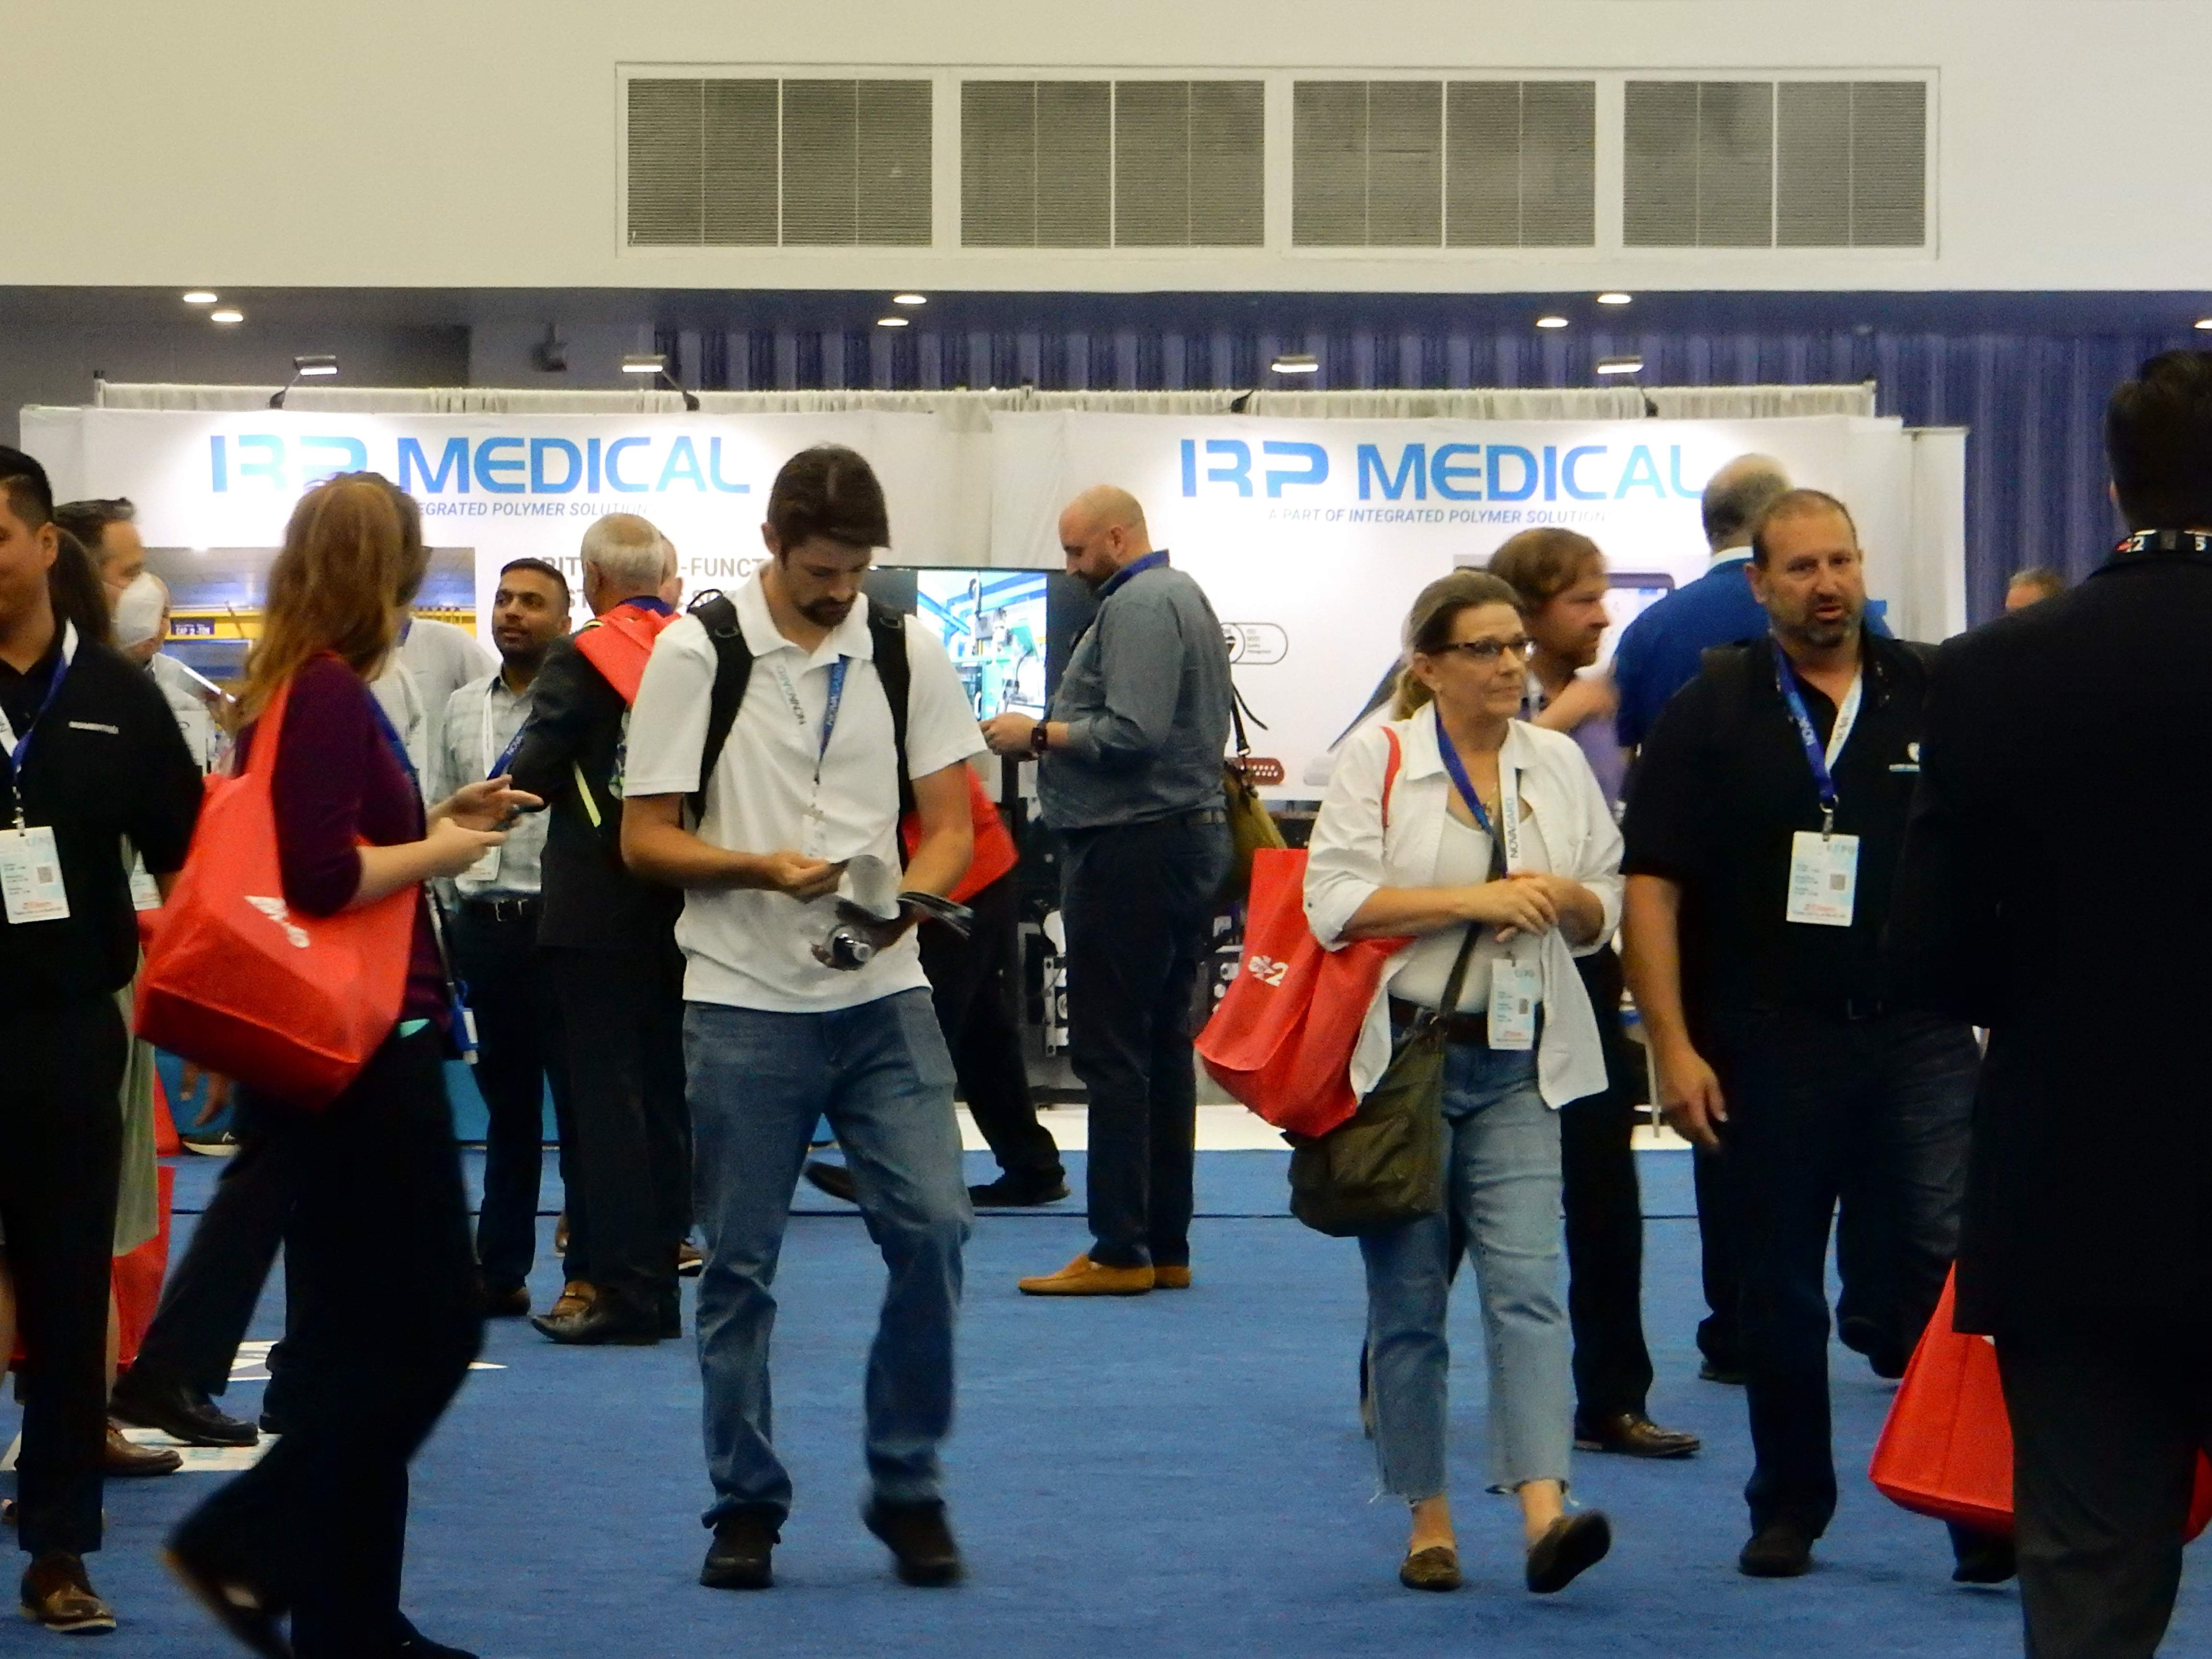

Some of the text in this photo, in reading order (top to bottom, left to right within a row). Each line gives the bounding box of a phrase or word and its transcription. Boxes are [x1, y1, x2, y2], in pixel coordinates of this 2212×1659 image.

[210, 434, 750, 494] IRP MEDICAL
[1180, 439, 1702, 501] IRP MEDICAL
[493, 502, 565, 516] POLYMER
[1268, 509, 1276, 520] A
[1283, 509, 1322, 521] PART
[1324, 509, 1346, 522] OF
[1349, 509, 1443, 523] INTEGRATED
[1449, 510, 1521, 524] POLYMER
